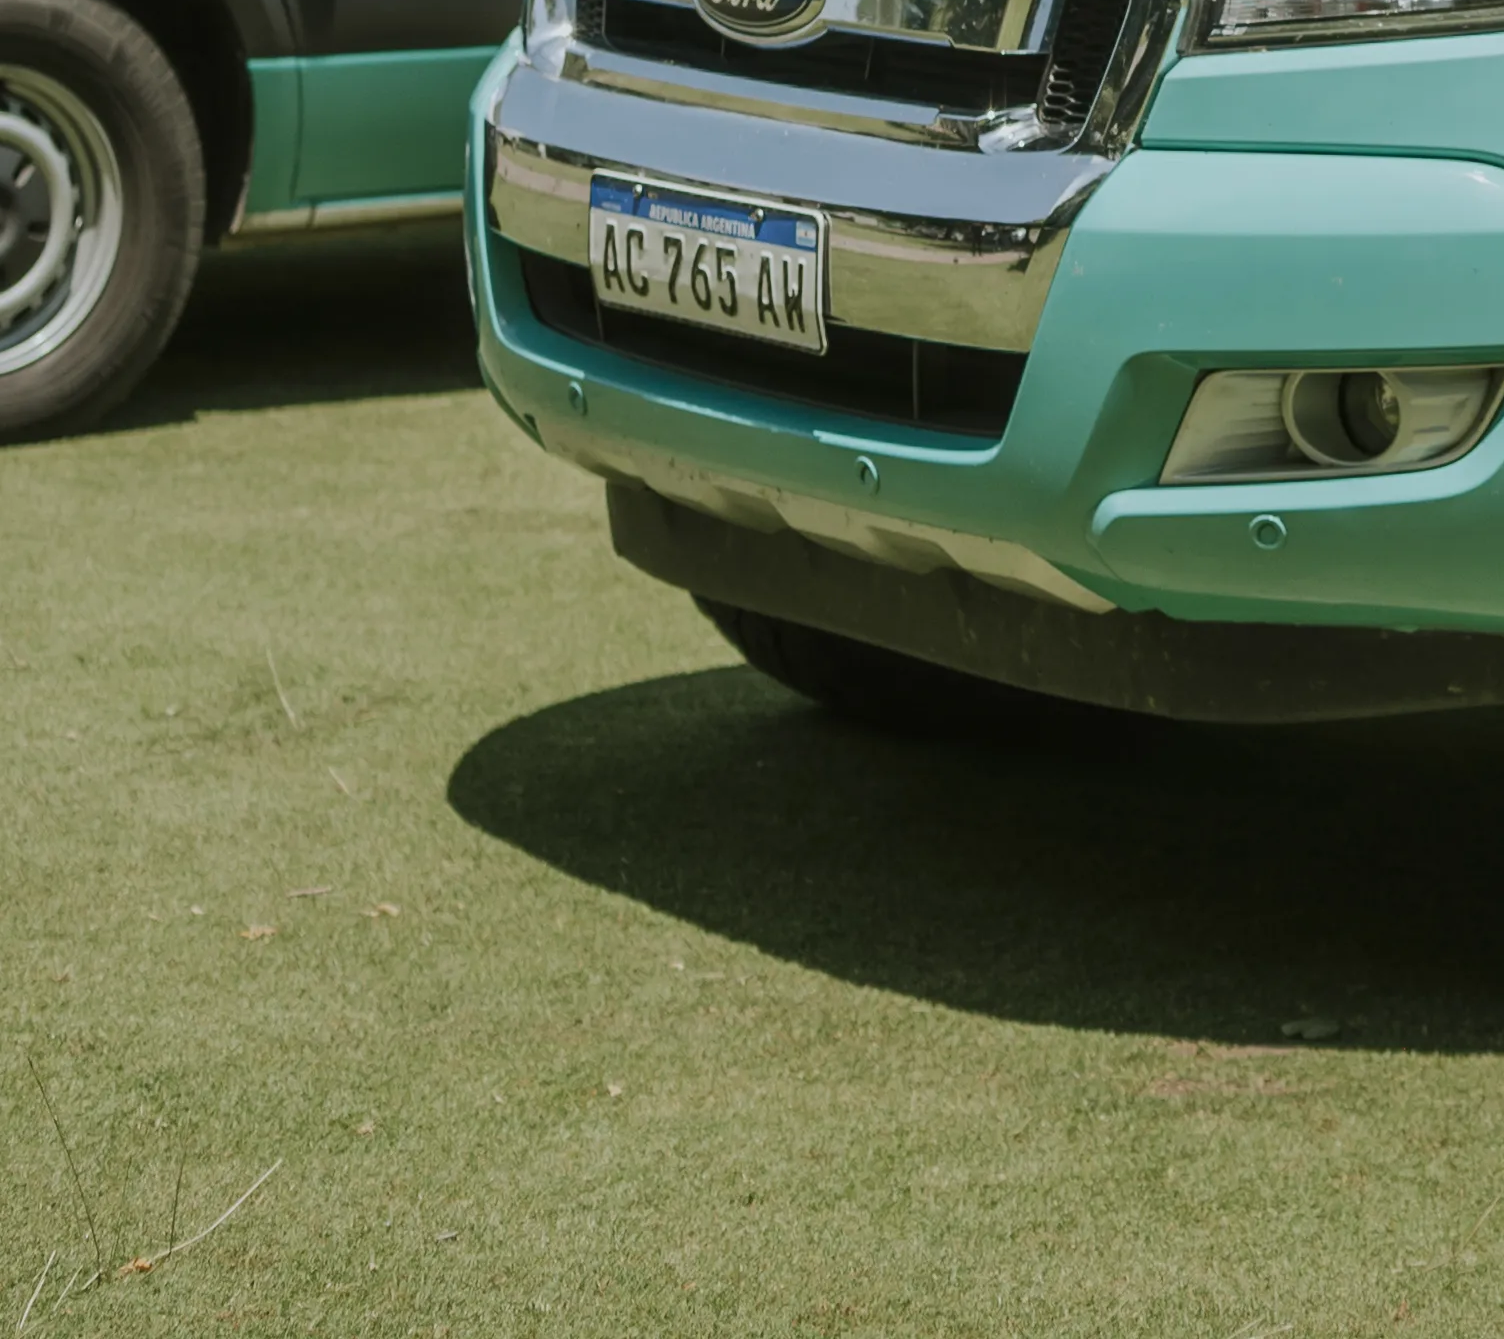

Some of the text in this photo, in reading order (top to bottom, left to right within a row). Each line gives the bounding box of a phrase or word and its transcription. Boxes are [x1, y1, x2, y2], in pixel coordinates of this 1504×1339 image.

[700, 213, 757, 240] ARGENTINA
[603, 221, 649, 298] AC
[663, 233, 739, 318] 765
